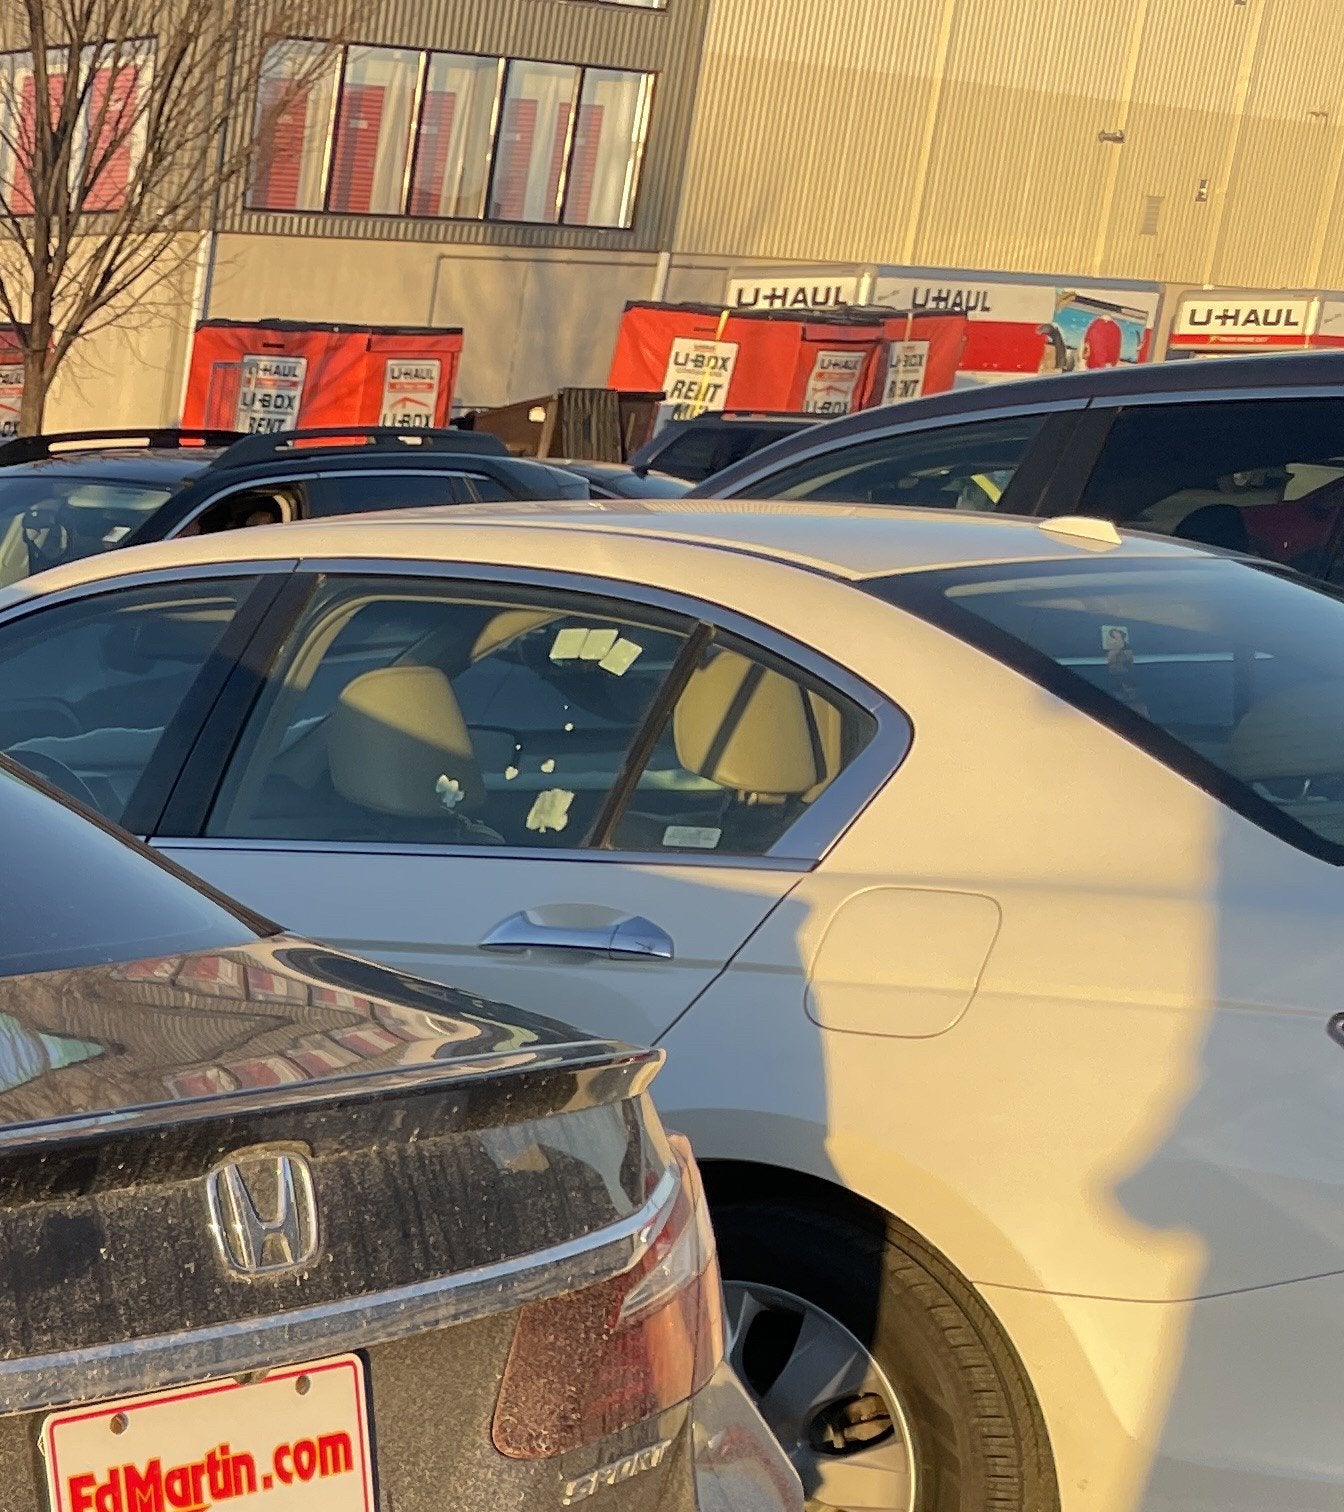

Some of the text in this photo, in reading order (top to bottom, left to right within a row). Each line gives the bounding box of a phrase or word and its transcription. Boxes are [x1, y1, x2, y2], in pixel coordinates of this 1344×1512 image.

[737, 286, 847, 308] U-HAUL
[912, 286, 991, 313] U-HAUL
[1189, 308, 1299, 326] U-HAUL
[390, 367, 434, 381] U-HAUL
[241, 393, 296, 410] U-BOX
